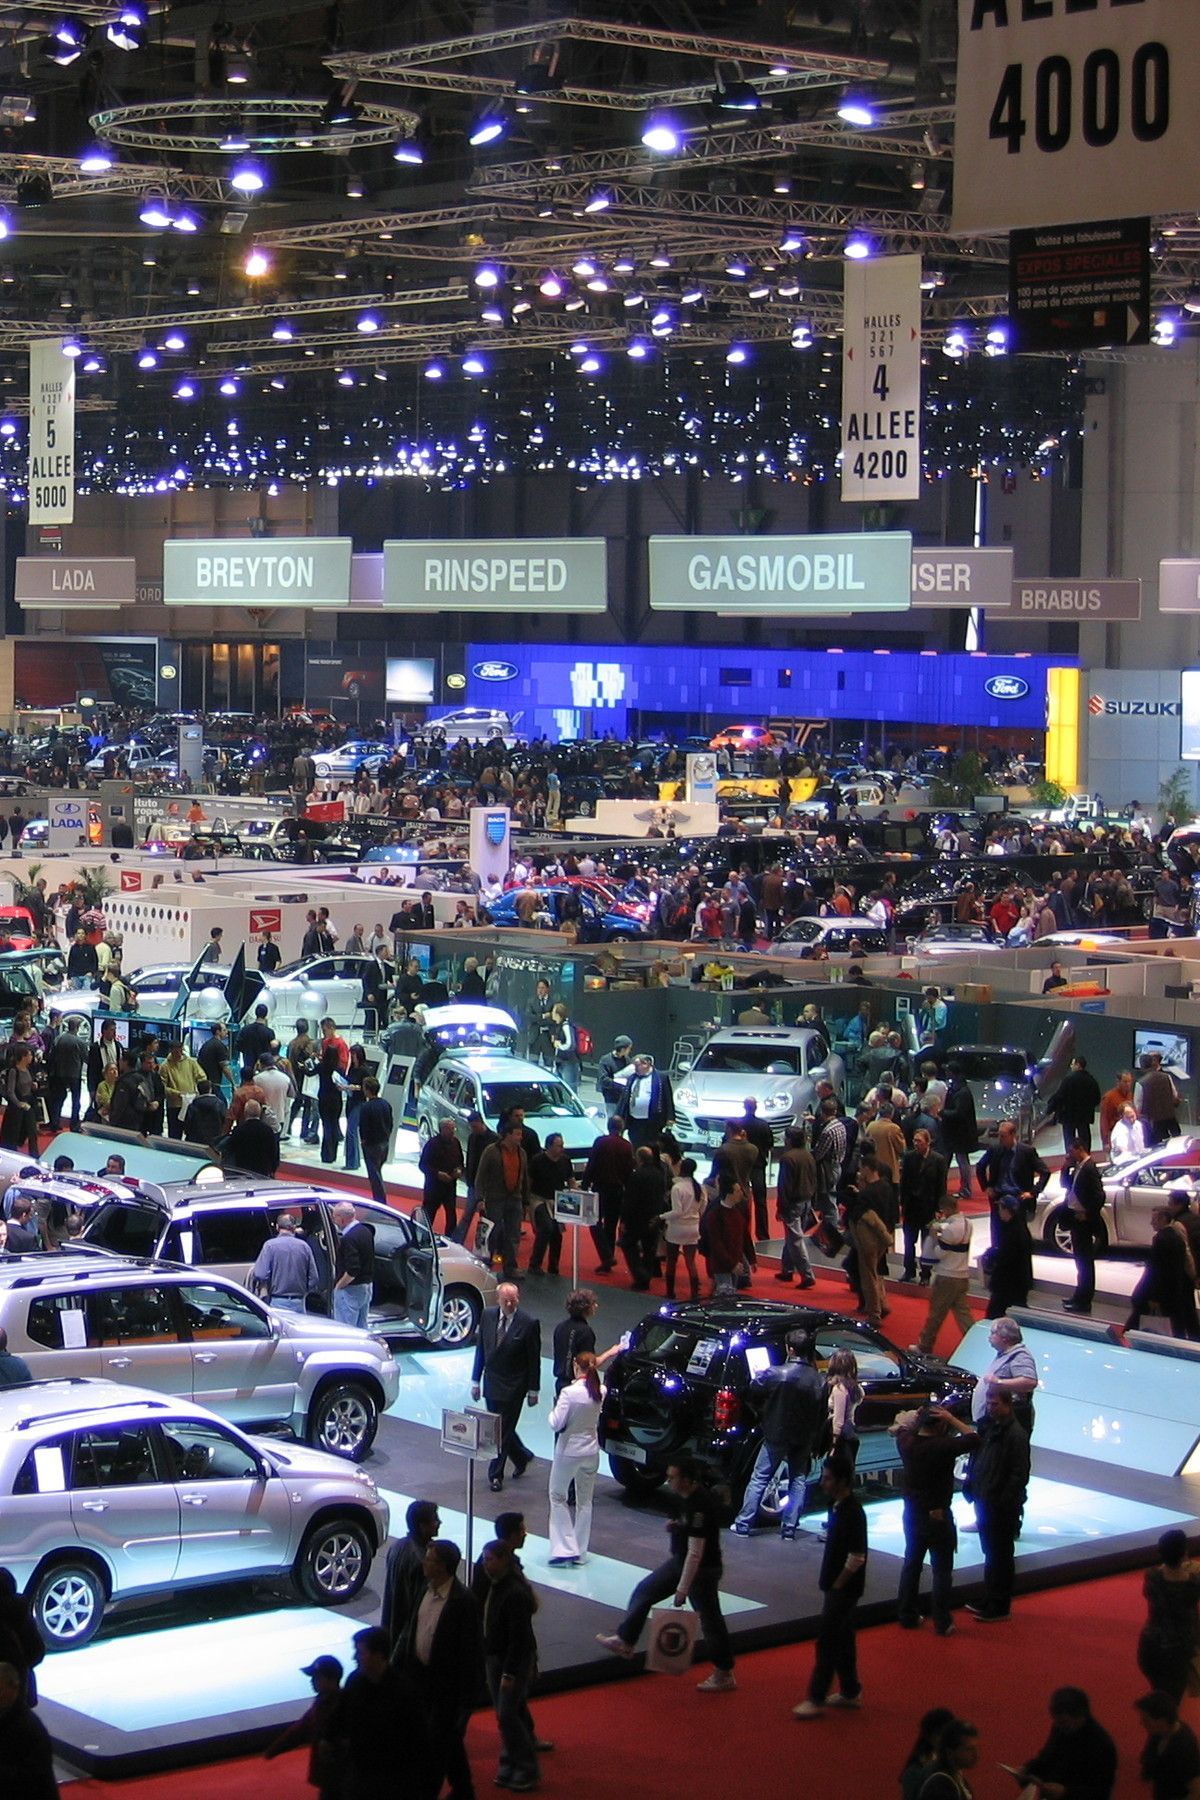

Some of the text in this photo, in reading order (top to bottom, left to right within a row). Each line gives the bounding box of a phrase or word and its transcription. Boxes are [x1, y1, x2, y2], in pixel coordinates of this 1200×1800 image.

[989, 42, 1170, 154] 4000
[1063, 233, 1075, 243] les
[1018, 258, 1061, 276] EXPOS
[1017, 287, 1032, 297] 100
[1032, 287, 1047, 297] ans
[1048, 285, 1059, 295] de
[1017, 299, 1032, 310] 100
[864, 314, 901, 328] HALLES
[873, 364, 889, 401] 4
[47, 420, 56, 448] 5
[848, 410, 915, 441] ALLEE
[32, 455, 71, 478] ALLEE
[854, 450, 908, 479] 4200
[36, 486, 67, 507] 5000
[51, 569, 95, 591] LADA
[196, 556, 314, 588] BREYTON
[424, 558, 568, 592] RINSPEED
[688, 553, 865, 591] GASMOBIL
[1021, 588, 1101, 611] BRABUS
[480, 664, 509, 678] Ford
[992, 678, 1020, 695] Ford
[1105, 700, 1181, 716] SUZUKI
[51, 818, 84, 828] LADA
